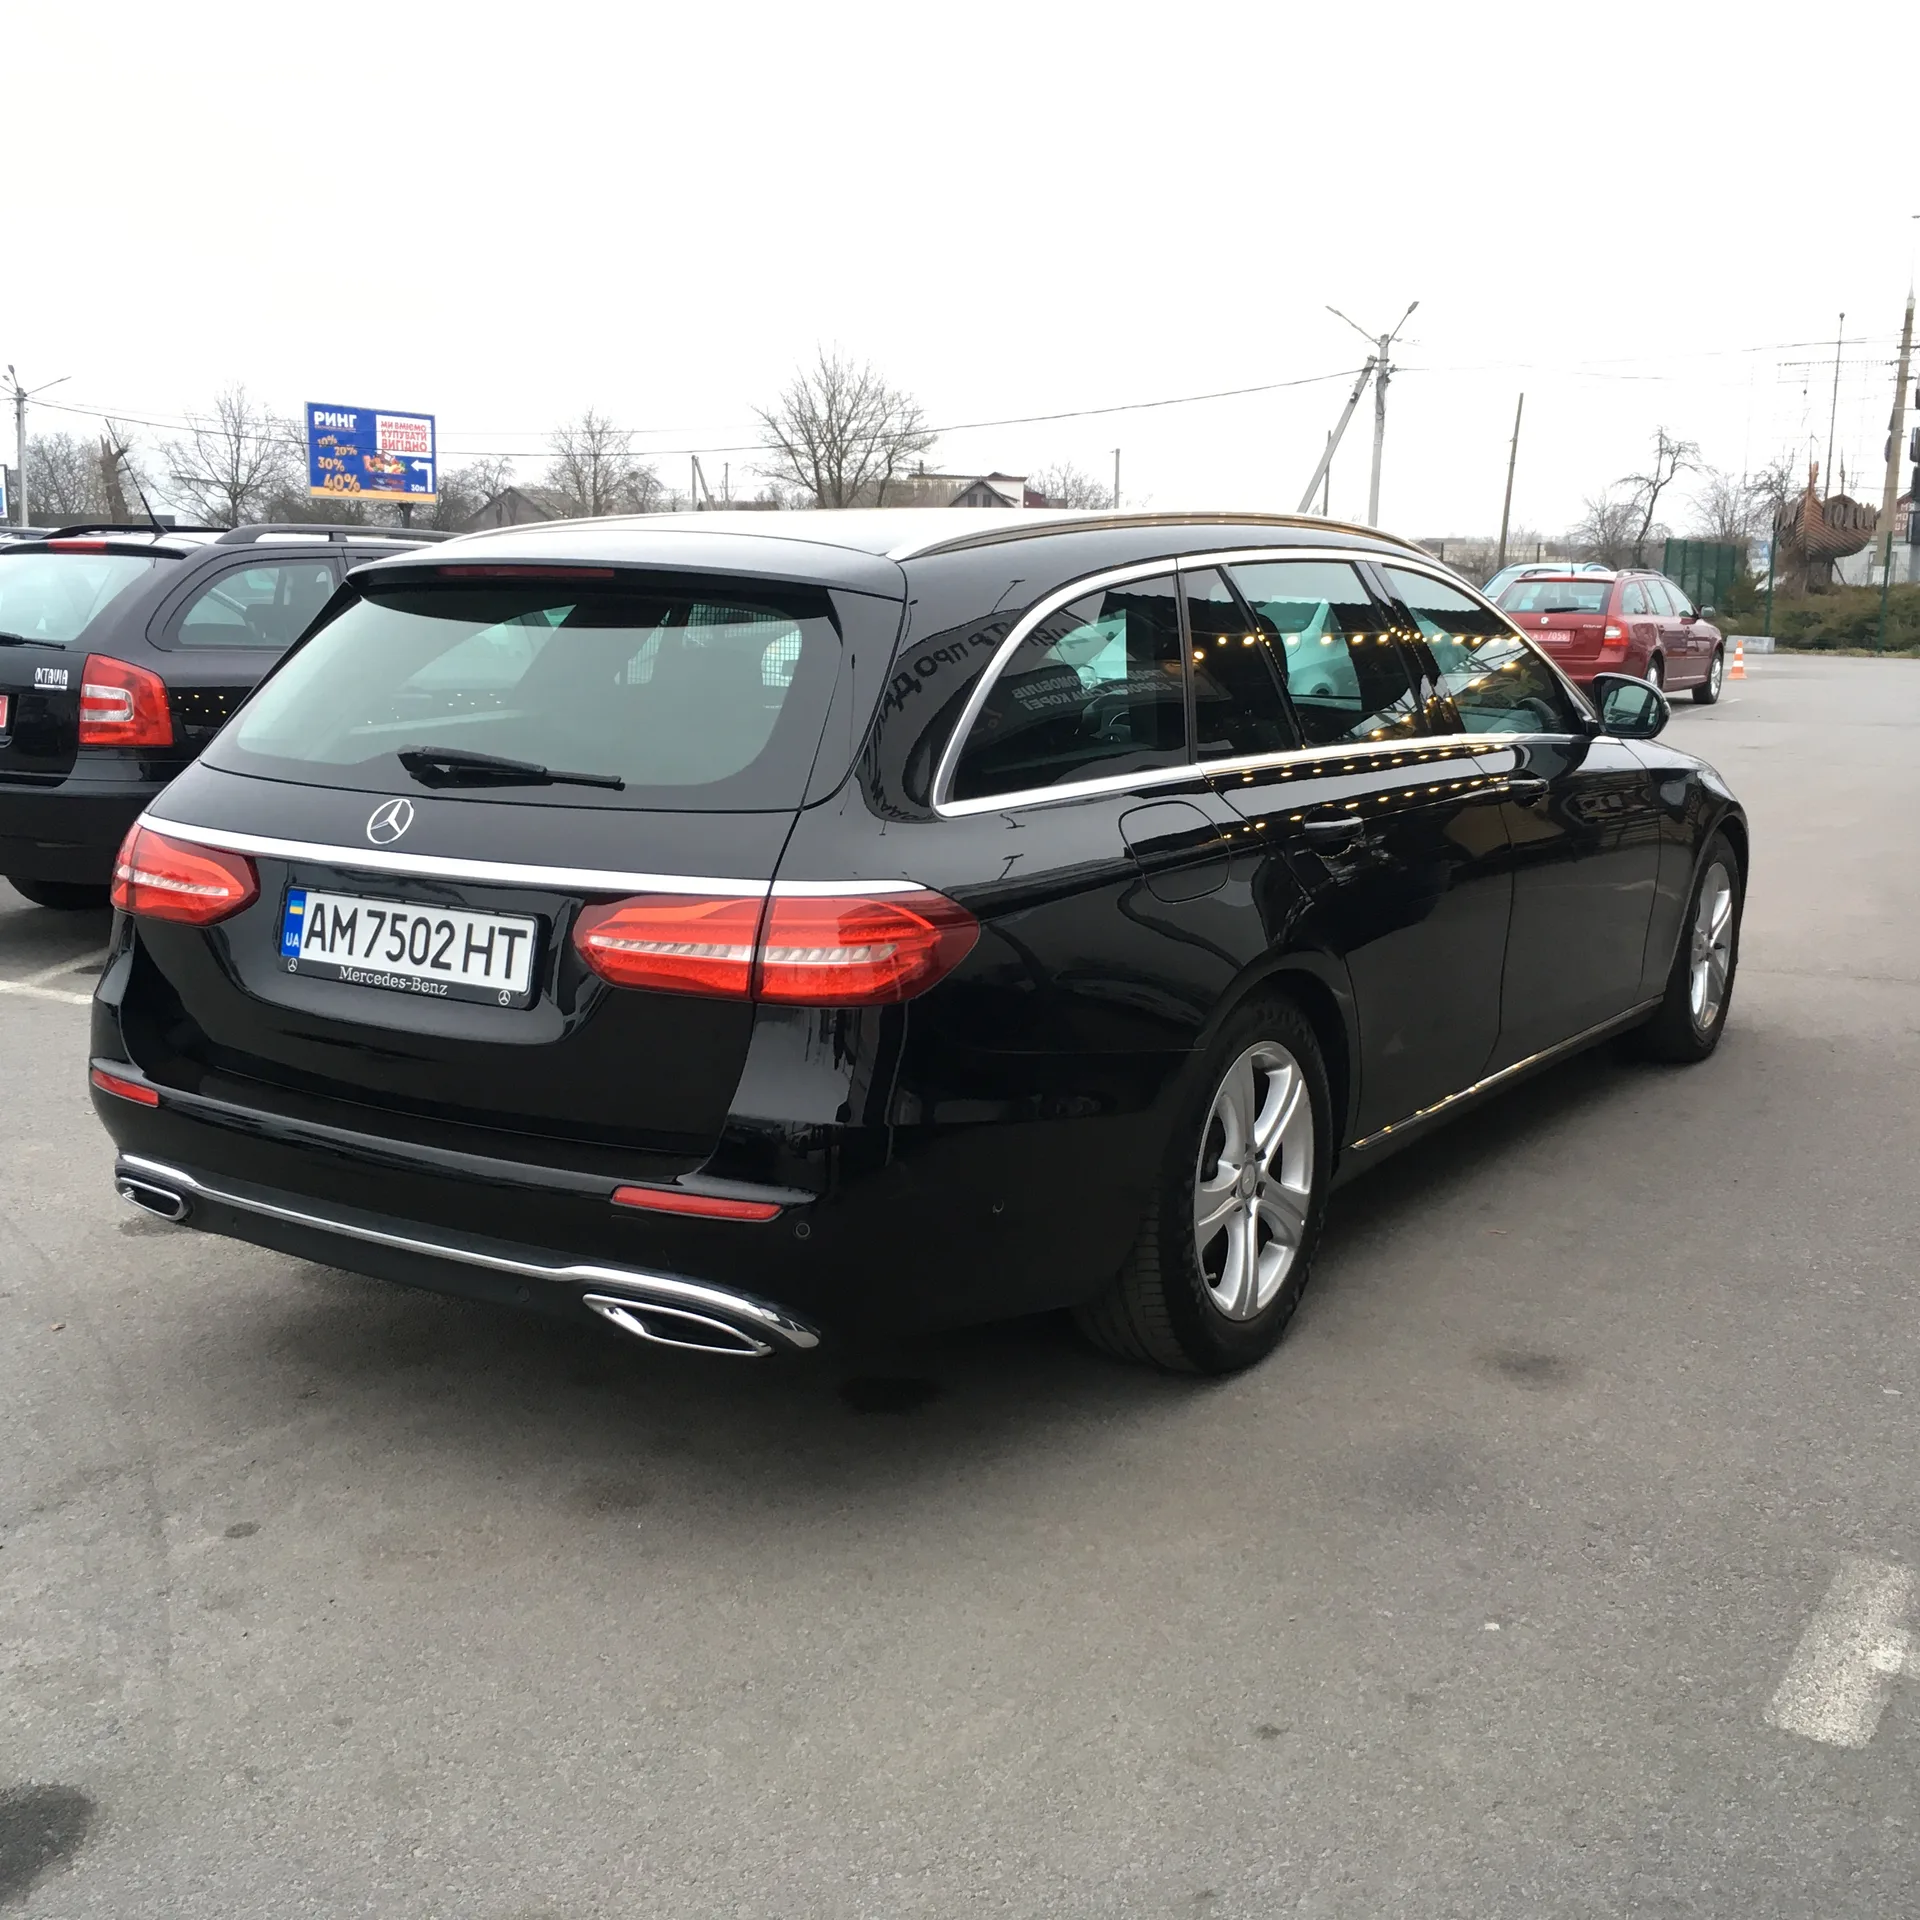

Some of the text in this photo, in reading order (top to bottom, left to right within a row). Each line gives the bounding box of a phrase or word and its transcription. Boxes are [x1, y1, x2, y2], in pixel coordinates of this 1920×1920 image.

[314, 411, 357, 428] РИНГ
[381, 430, 427, 441] КУПУВАТИ
[334, 444, 357, 456] 20%
[381, 439, 428, 452] ВИГІДНО
[318, 456, 345, 472] 30%
[323, 473, 361, 492] 40%
[34, 668, 69, 685] OCTAVIA
[285, 931, 299, 948] UA
[339, 966, 448, 996] Mercedes-Benz
